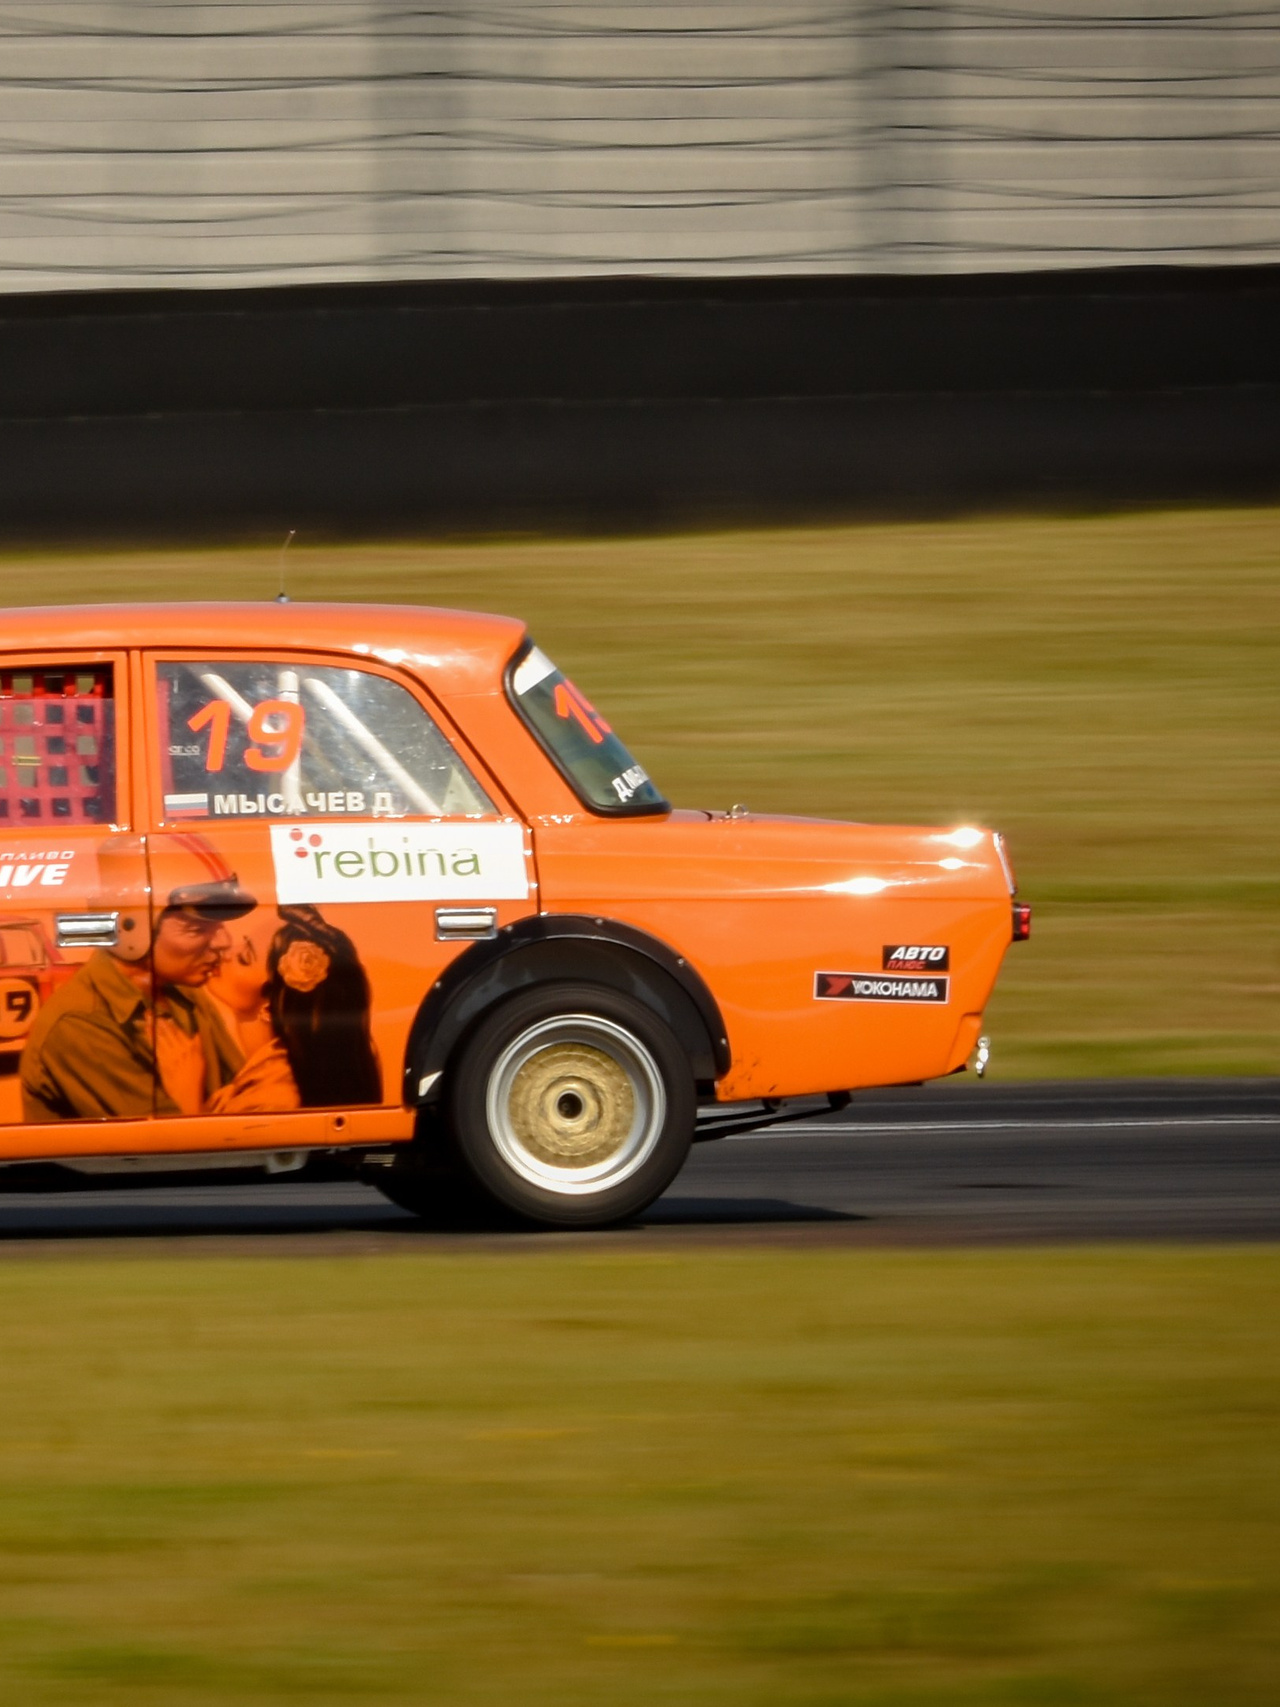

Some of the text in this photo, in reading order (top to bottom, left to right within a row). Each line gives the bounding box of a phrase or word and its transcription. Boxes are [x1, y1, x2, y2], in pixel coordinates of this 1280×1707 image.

[187, 699, 306, 773] 19
[213, 792, 366, 815] МЫСАЧЕВ
[314, 837, 481, 879] rebina
[890, 946, 946, 961] АВТО
[851, 980, 938, 997] YOKOHAMA
